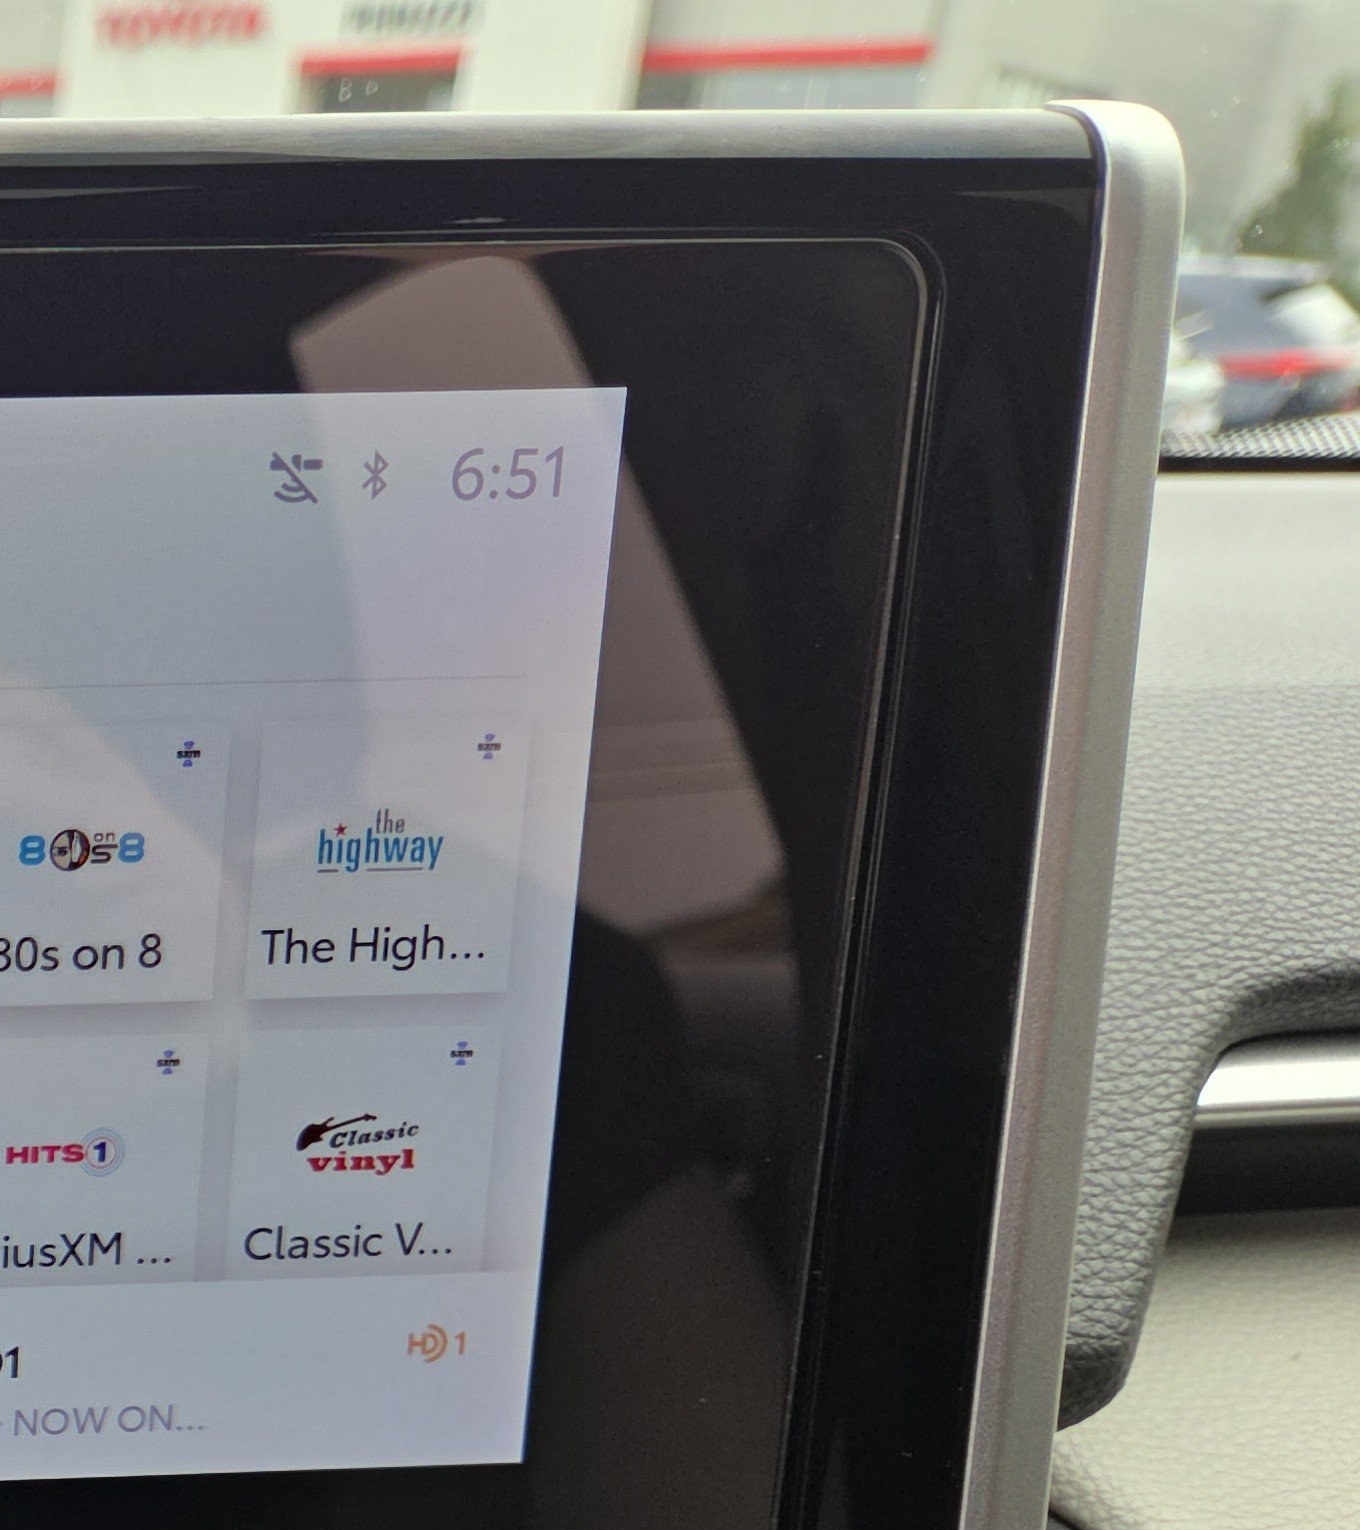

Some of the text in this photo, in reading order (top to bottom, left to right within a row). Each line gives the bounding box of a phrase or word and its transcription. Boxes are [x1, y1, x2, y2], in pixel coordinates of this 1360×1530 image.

[451, 446, 568, 501] 6:51
[375, 808, 406, 834] the
[316, 826, 445, 873] highway
[72, 944, 125, 970] on
[138, 933, 163, 968] 8
[261, 923, 485, 971] The High...
[4, 1141, 108, 1165] HITS 1
[329, 1121, 420, 1150] Classic
[306, 1148, 415, 1176] vinyl
[243, 1224, 384, 1261] Classic
[12, 1406, 110, 1438] NOW
[116, 1403, 208, 1434] ON...
